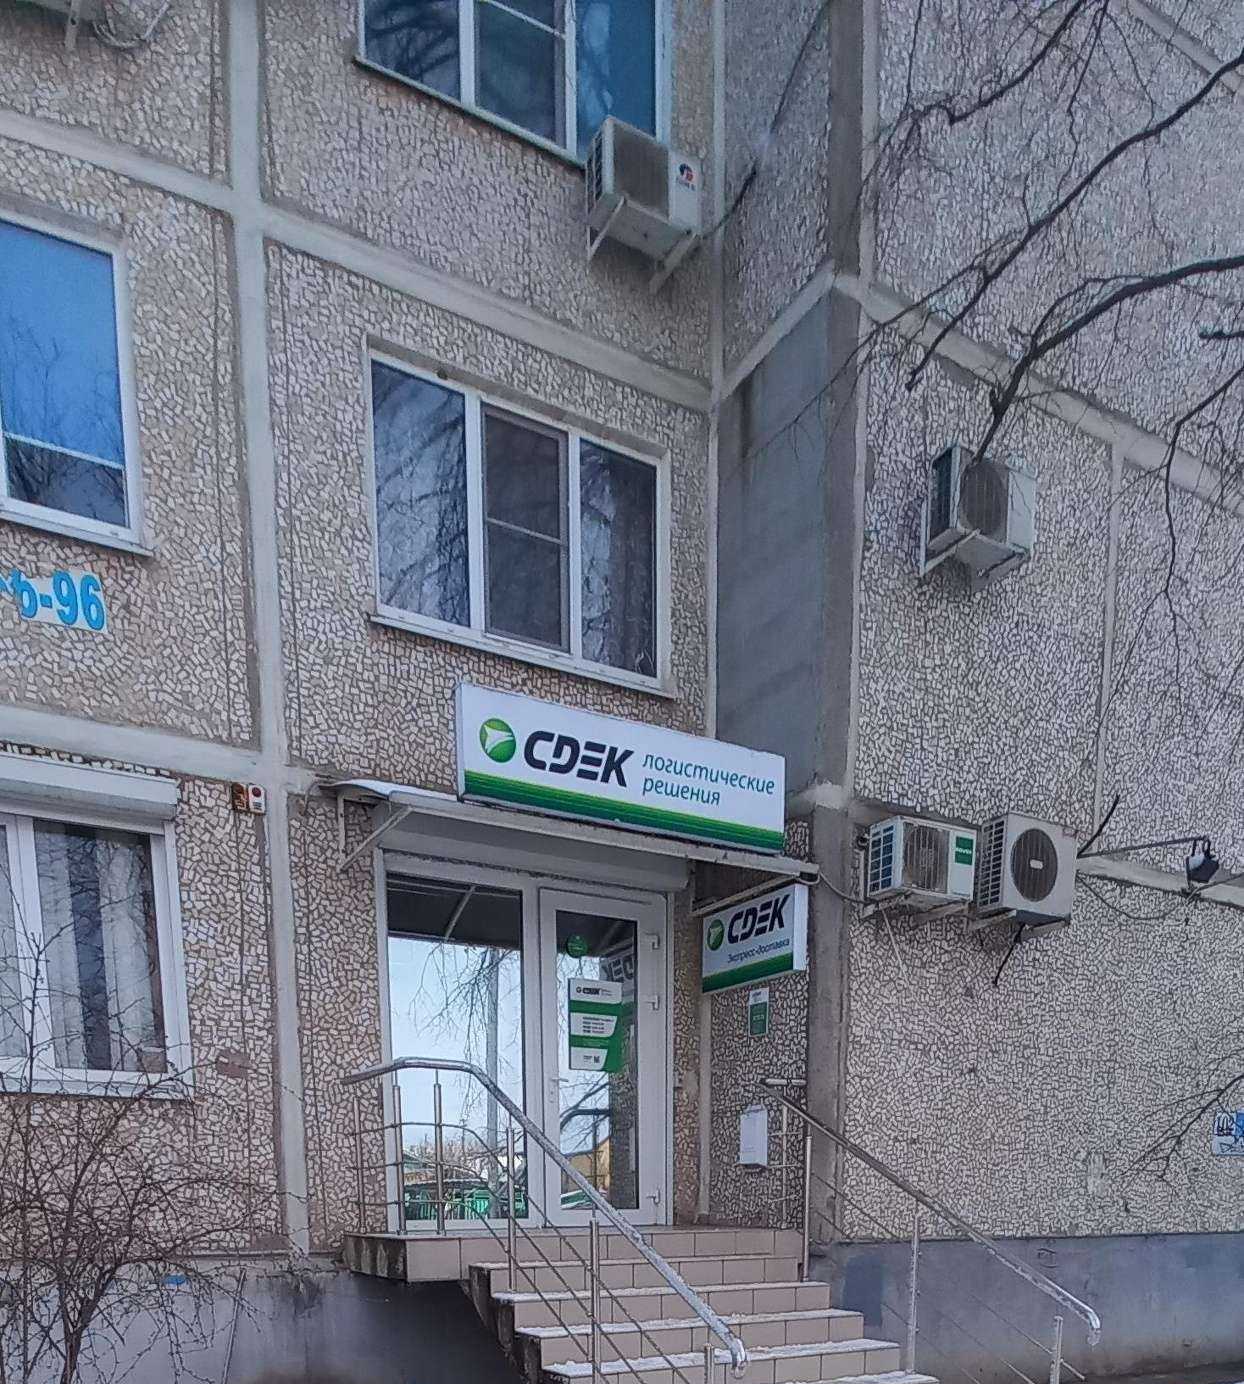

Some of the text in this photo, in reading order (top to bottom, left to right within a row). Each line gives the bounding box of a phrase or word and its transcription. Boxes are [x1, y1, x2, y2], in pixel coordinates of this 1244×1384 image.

[523, 730, 634, 788] CDEK
[642, 754, 775, 795] логистические
[642, 776, 721, 806] решения
[727, 894, 791, 944] CDEK
